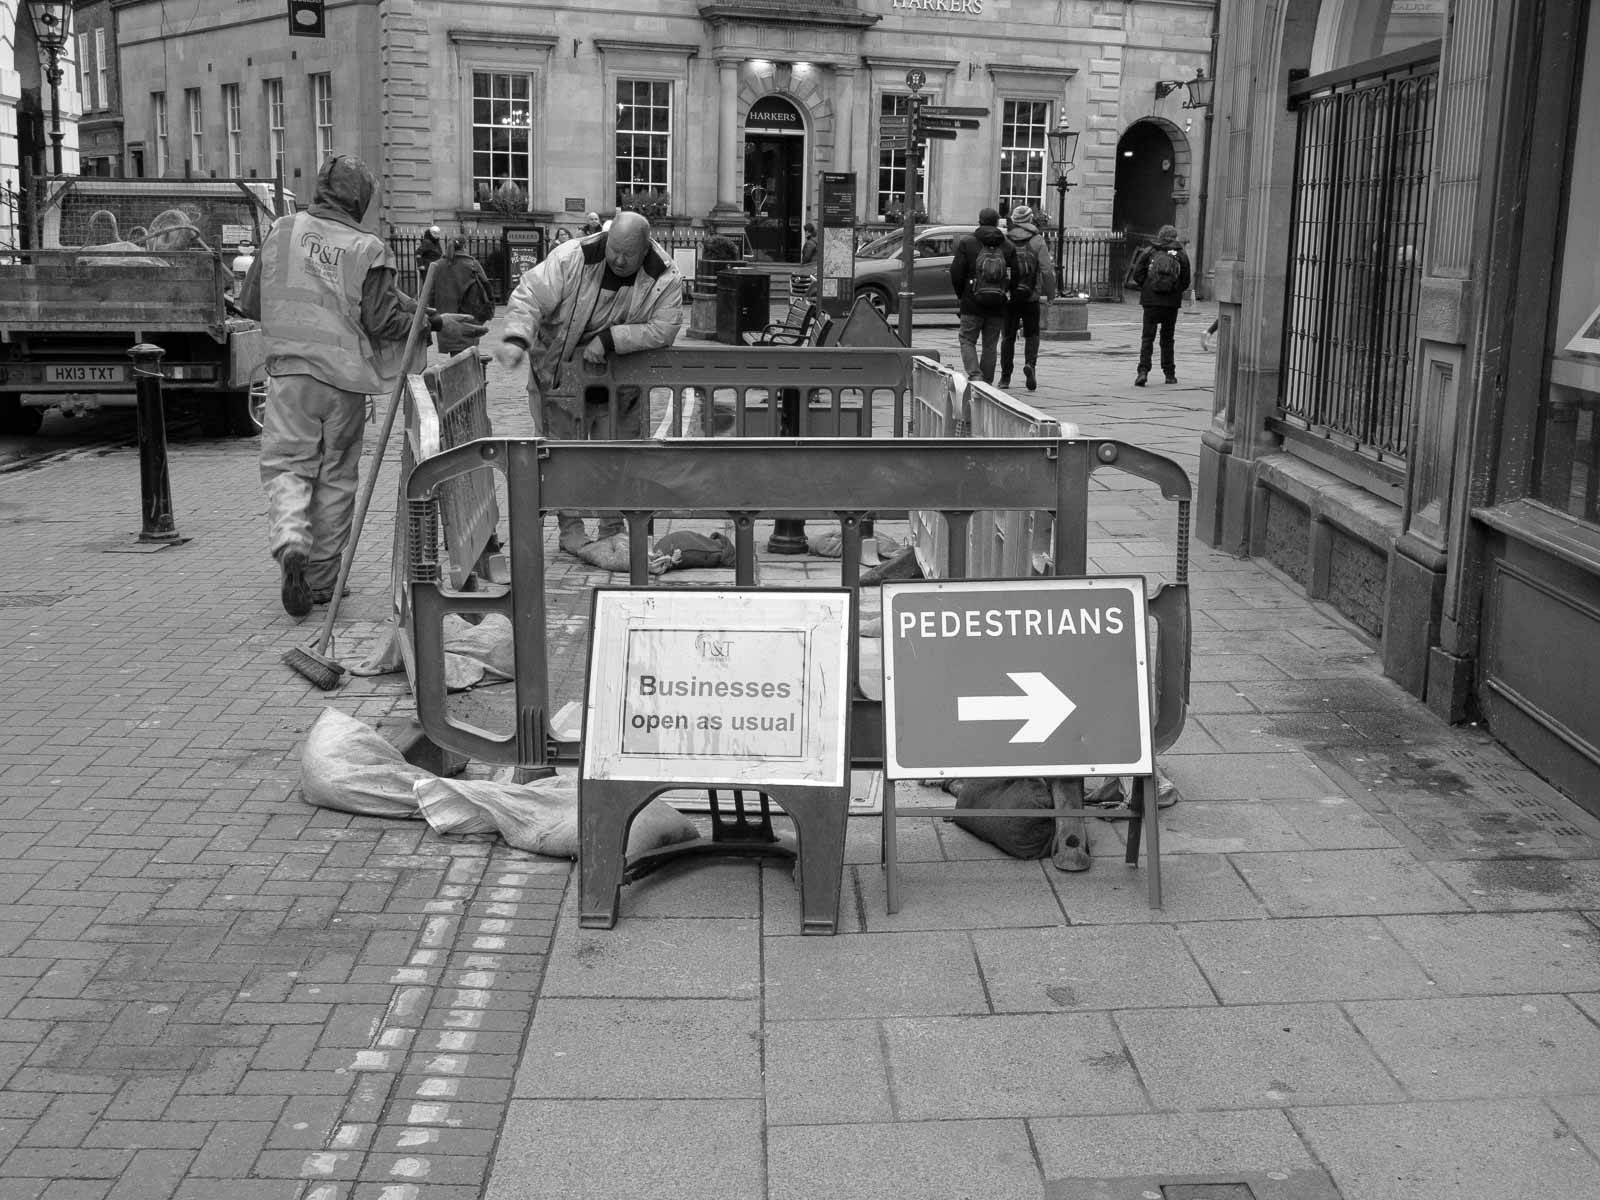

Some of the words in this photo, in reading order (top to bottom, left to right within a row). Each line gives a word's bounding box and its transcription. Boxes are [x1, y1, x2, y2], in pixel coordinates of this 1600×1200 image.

[750, 111, 796, 121] HARKERS
[55, 367, 86, 380] HX13
[89, 367, 115, 380] TXT
[899, 607, 1124, 638] PEDESTRIANS
[639, 675, 791, 698] Businesses
[631, 714, 689, 734] open
[696, 715, 723, 730] as
[731, 713, 795, 732] usual
